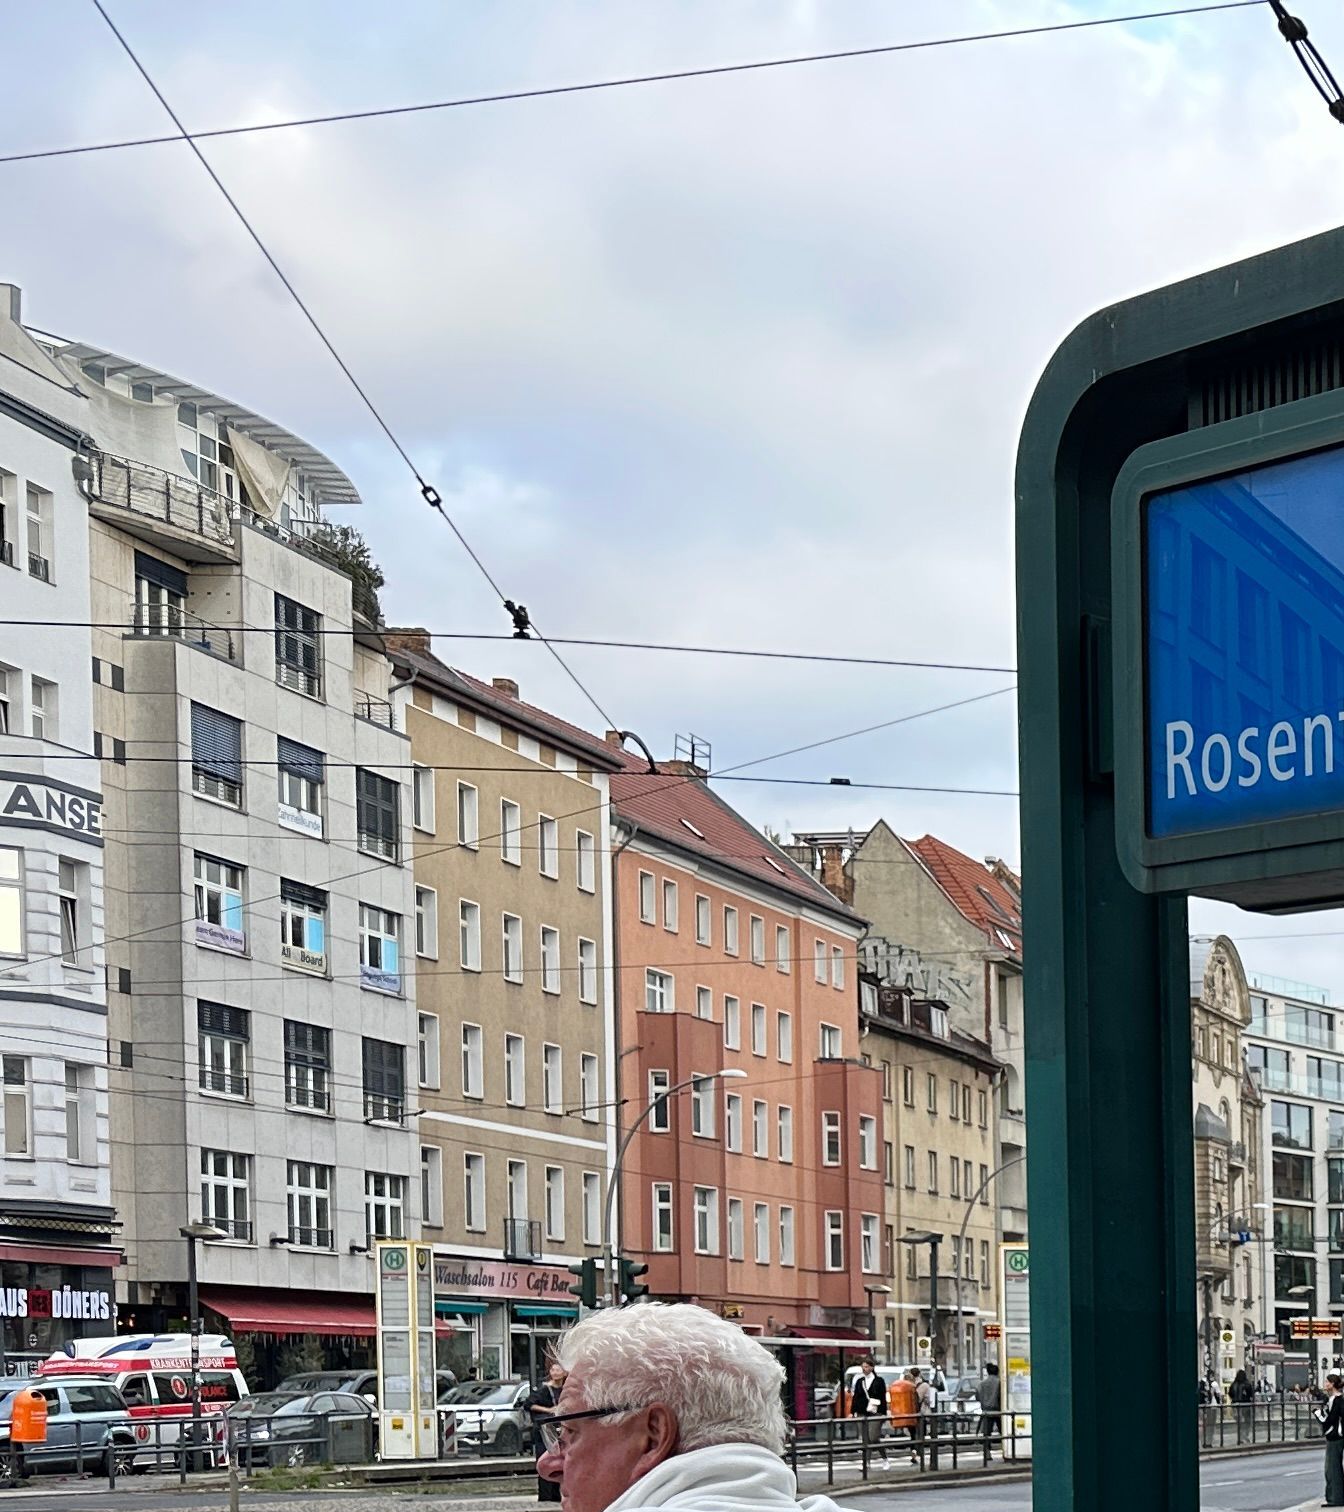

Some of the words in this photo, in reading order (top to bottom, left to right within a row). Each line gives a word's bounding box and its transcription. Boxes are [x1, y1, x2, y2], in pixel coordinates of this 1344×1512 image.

[3, 784, 101, 835] ANSE
[434, 1265, 495, 1288] Waschsalon
[500, 1271, 518, 1289] 115
[52, 1285, 110, 1320] DÖNERS
